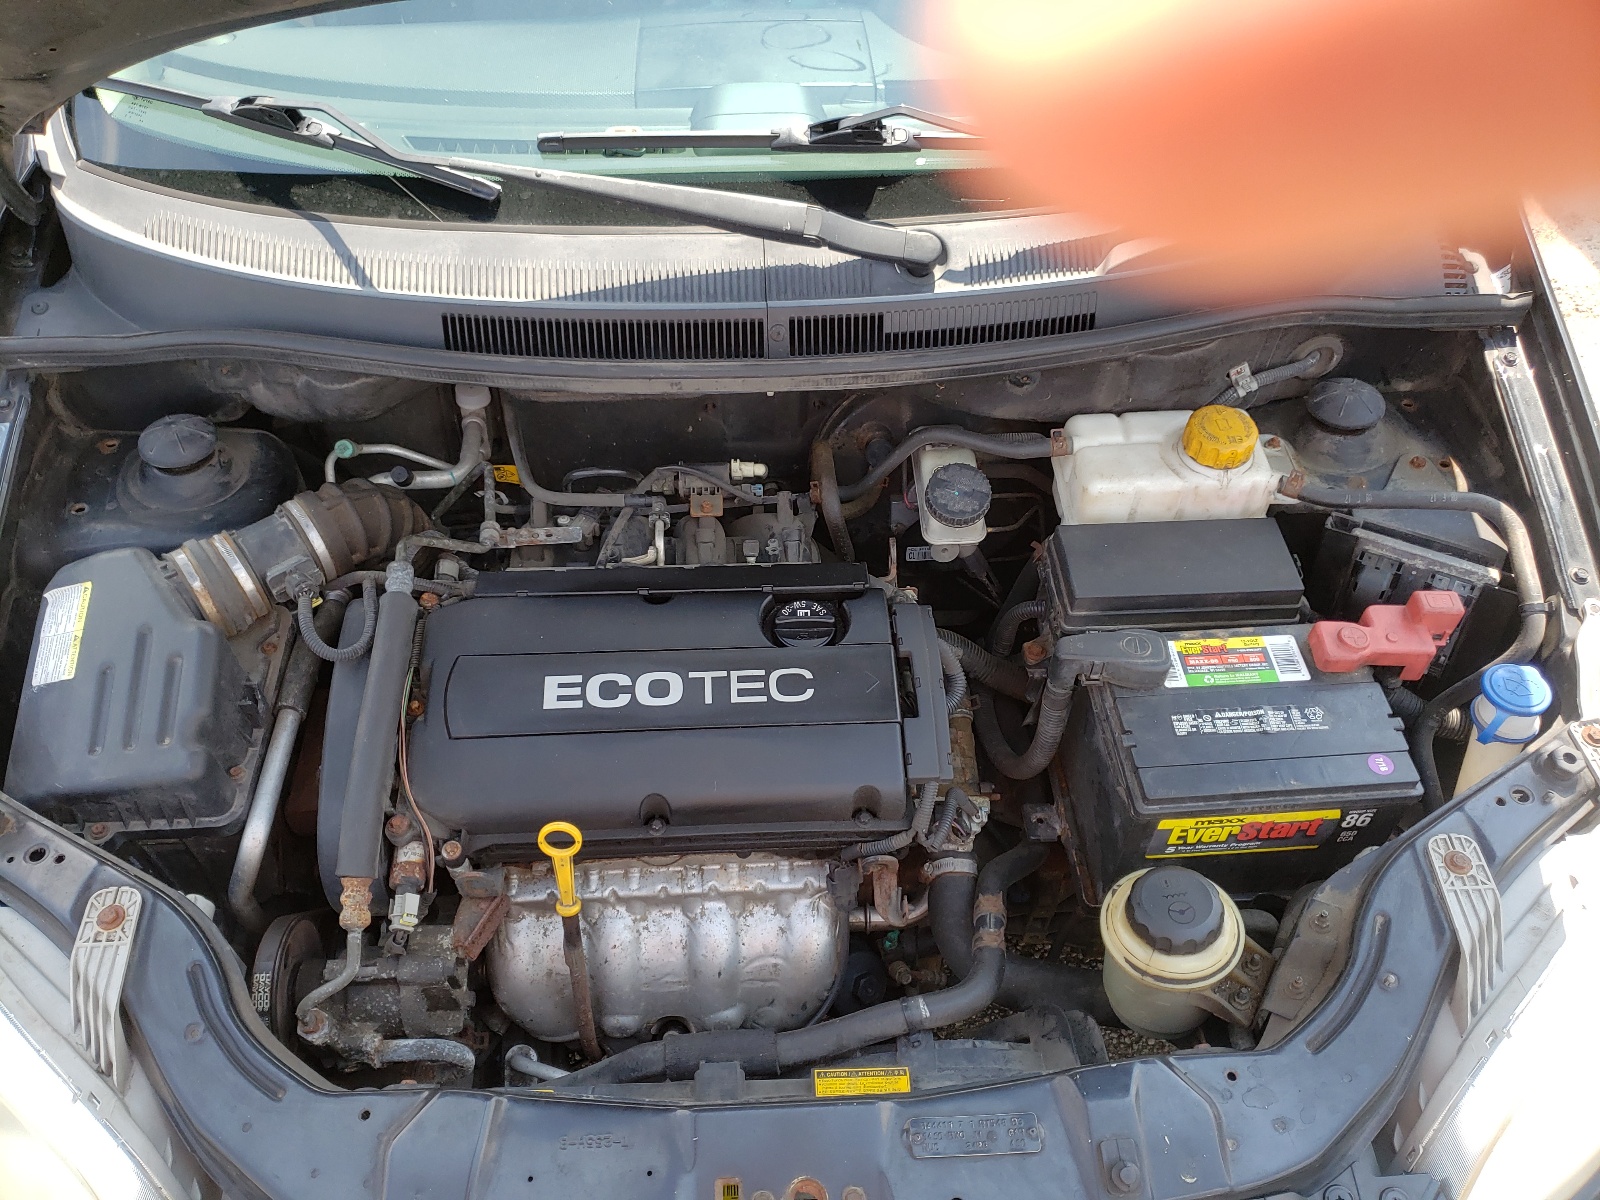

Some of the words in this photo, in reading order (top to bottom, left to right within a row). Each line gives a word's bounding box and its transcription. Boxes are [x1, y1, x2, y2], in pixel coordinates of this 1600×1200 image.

[781, 600, 807, 616] 5W-30
[811, 602, 827, 616] SAE
[1180, 643, 1229, 655] EverStart
[543, 667, 815, 709] ECOTEC
[1193, 817, 1247, 827] maxx
[1341, 813, 1374, 828] 86
[1167, 817, 1324, 845] EverStart
[1164, 846, 1177, 854] 5
[257, 973, 266, 1008] DAYCO
